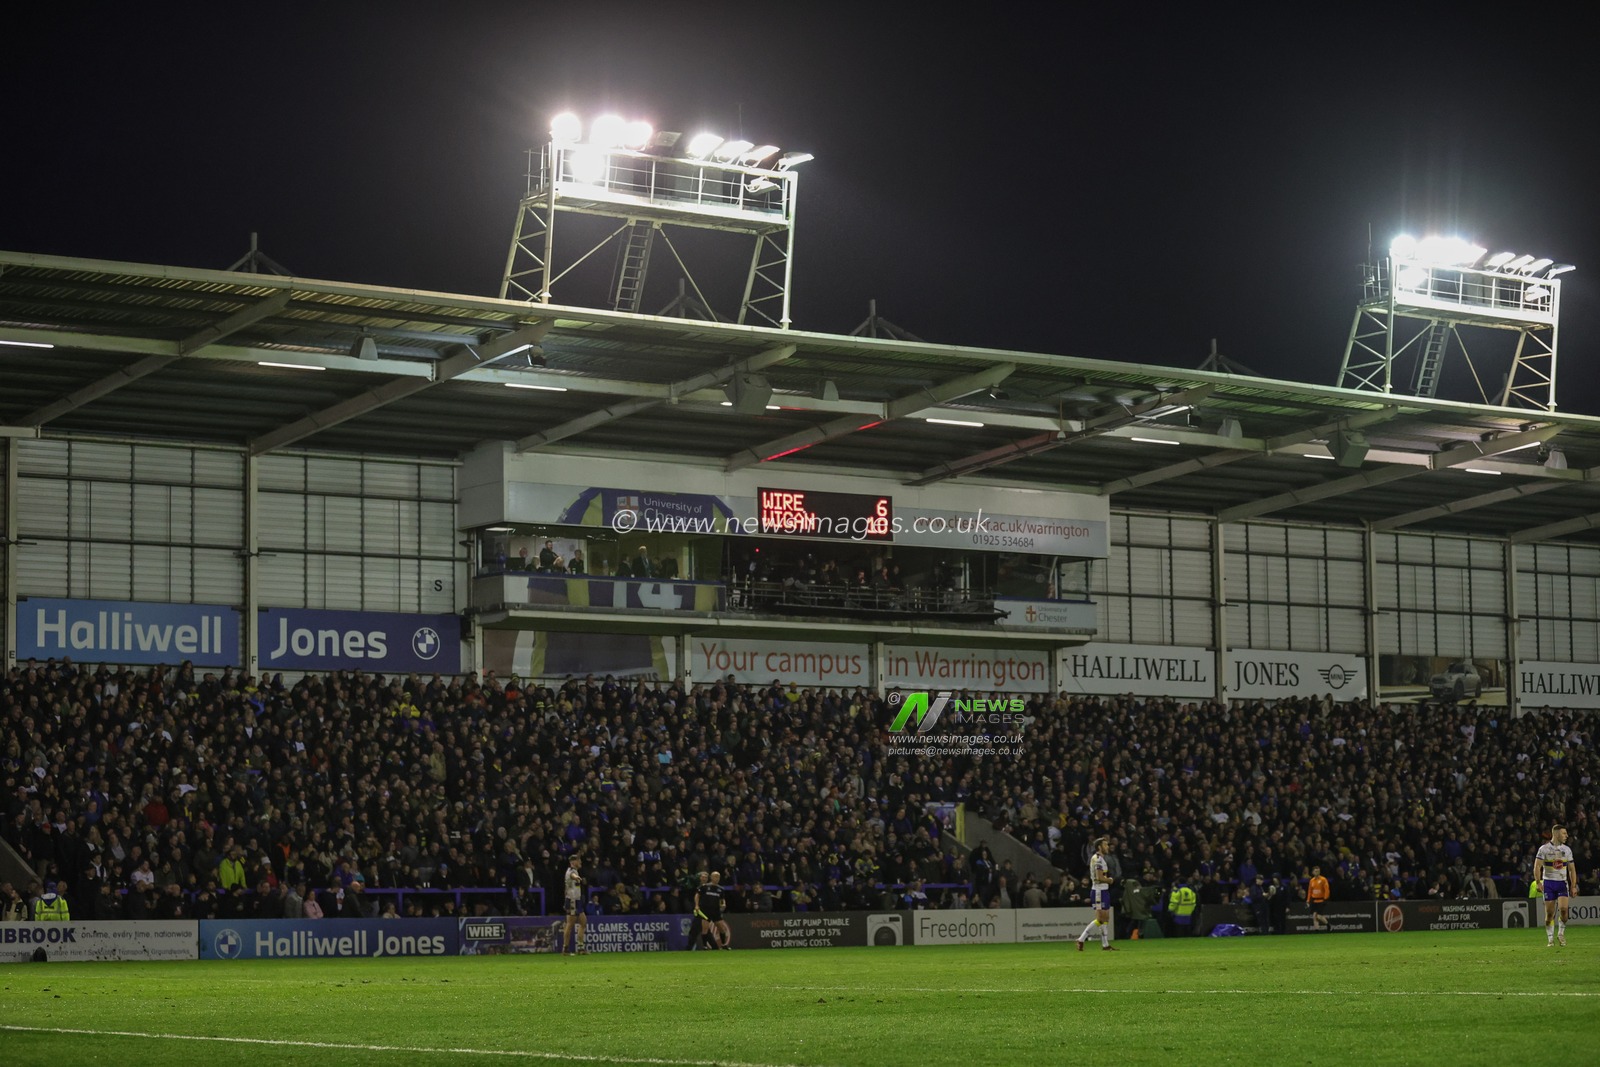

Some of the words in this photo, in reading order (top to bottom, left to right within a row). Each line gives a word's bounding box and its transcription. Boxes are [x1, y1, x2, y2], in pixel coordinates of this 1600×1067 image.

[643, 498, 691, 513] University
[693, 505, 703, 514] of
[762, 492, 804, 511] WIRE
[876, 500, 888, 516] 6
[644, 508, 702, 528] Chester
[762, 510, 815, 530] WIGAN
[914, 515, 1090, 540] www.chester.ac.uk/warrington
[972, 534, 999, 546] 01925
[1002, 536, 1034, 548] 534684
[434, 580, 443, 592] S
[1038, 613, 1067, 622] Chester
[37, 608, 221, 654] Halliwell
[270, 617, 387, 660] Jones
[9, 651, 16, 659] E
[252, 656, 257, 664] F
[700, 643, 759, 672] Your
[765, 652, 862, 680] campus
[887, 650, 909, 677] in
[915, 651, 1045, 687] Warrington
[1072, 654, 1207, 683] HALLIWELL
[1234, 661, 1299, 692] JONES
[598, 922, 632, 932] GAMES,
[633, 922, 670, 932] CLASSIC
[783, 919, 802, 927] HEAT
[802, 918, 822, 927] PUMP
[822, 918, 850, 926] TUMBLE
[920, 917, 995, 938] Freedom
[0, 928, 76, 944] BROOK
[155, 930, 193, 938] nationwide
[468, 926, 500, 938] WIRE
[575, 933, 634, 943] ECOUNTERS
[635, 932, 654, 941] AND
[760, 929, 786, 938] DRYERS
[787, 929, 804, 937] SAVE
[805, 929, 816, 937] UP
[827, 928, 841, 936] 57%
[255, 930, 367, 957] Halliwell
[373, 929, 446, 957] Jones
[771, 940, 781, 948] ON
[783, 939, 808, 947] DRYING
